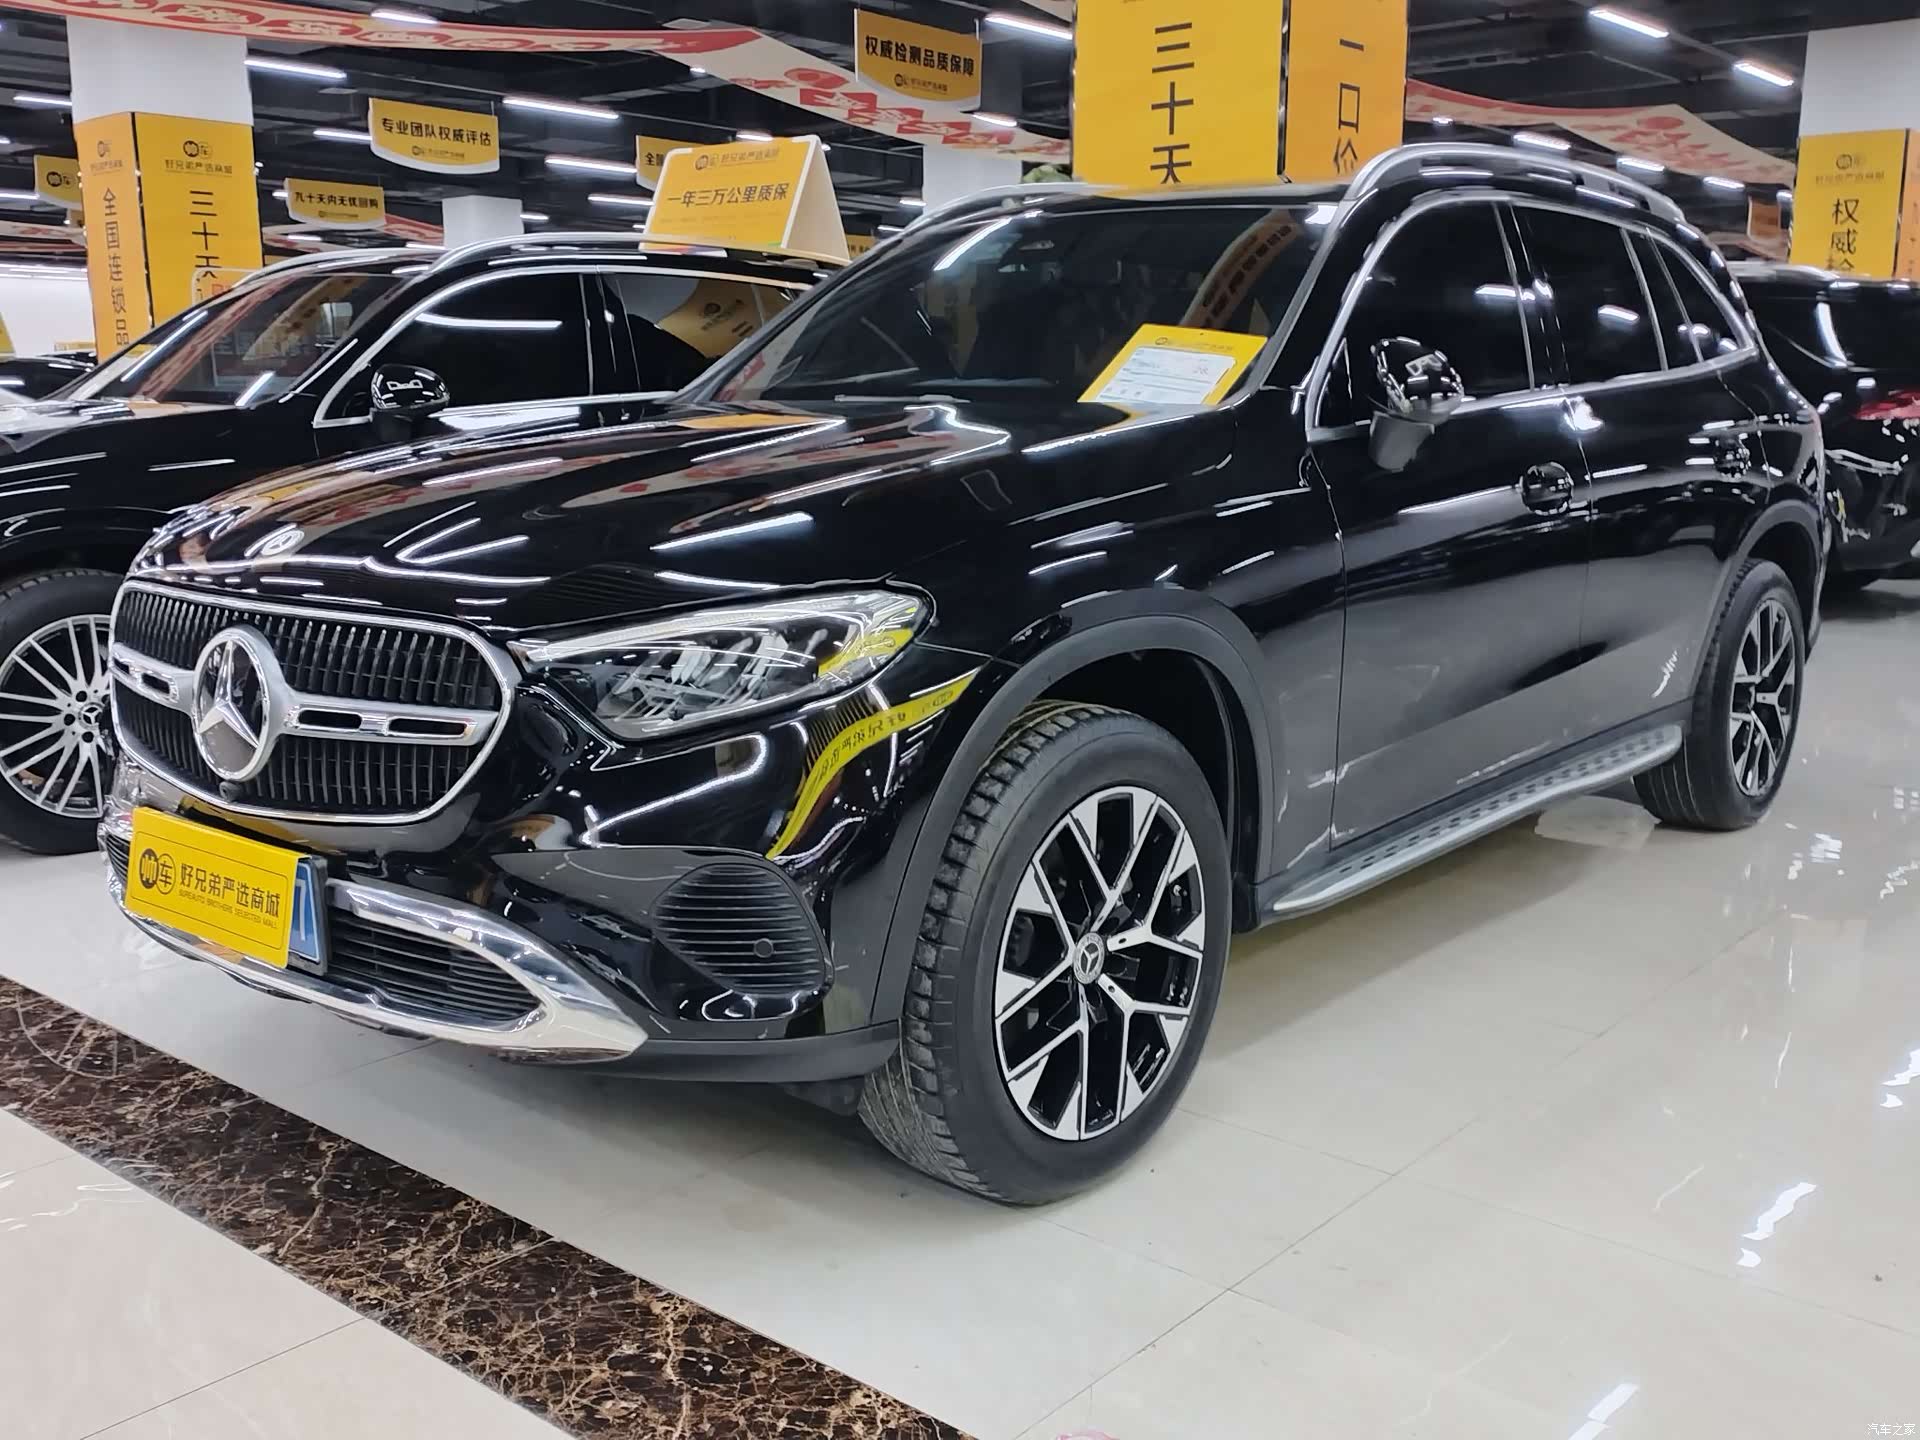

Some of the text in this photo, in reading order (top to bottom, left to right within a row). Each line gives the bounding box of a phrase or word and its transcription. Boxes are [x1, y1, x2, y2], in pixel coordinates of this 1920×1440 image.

[865, 35, 975, 77] 权威检测品质保障
[1150, 22, 1194, 184] 三十天
[1333, 38, 1364, 174] 一口价
[382, 117, 492, 146] 专业团队权威评估
[667, 183, 789, 208] 一年三万公里质保
[181, 863, 280, 918] 好兄弟严选商城
